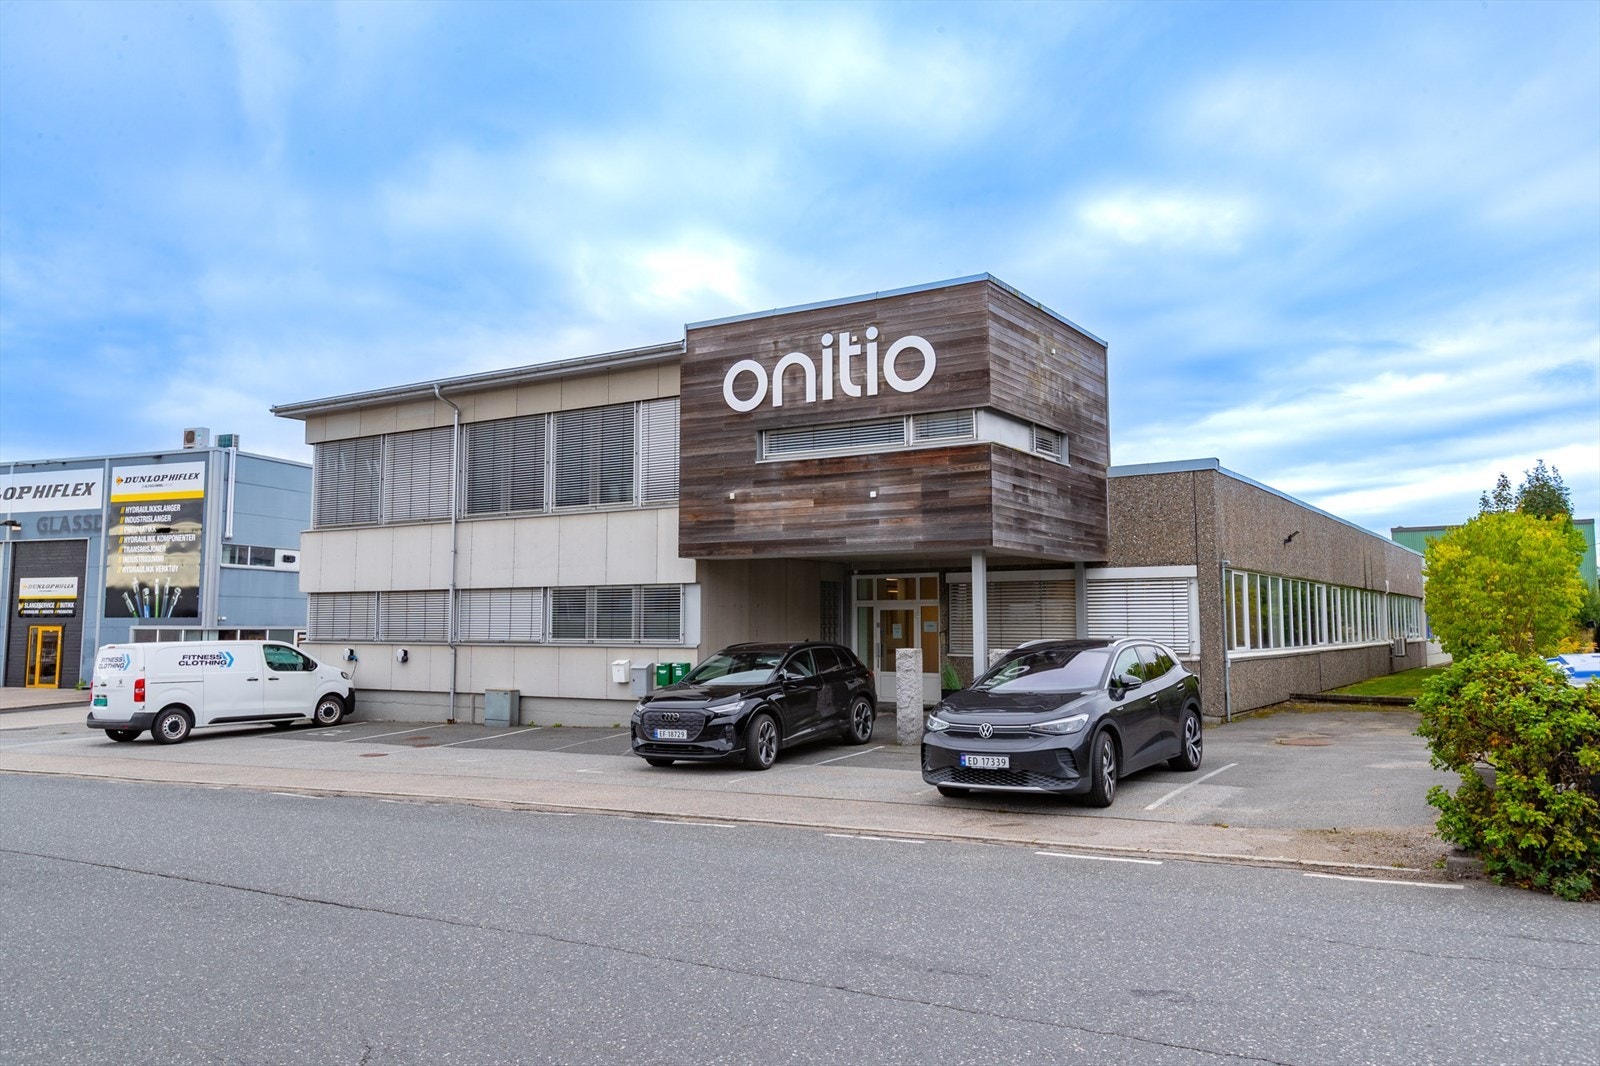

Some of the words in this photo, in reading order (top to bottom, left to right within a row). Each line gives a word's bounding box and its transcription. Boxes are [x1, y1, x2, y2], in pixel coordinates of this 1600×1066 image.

[723, 326, 937, 412] onitio
[0, 482, 96, 500] OPHIFLEX
[668, 730, 685, 738] 18729
[967, 756, 978, 766] ED
[981, 757, 1007, 767] 17339
